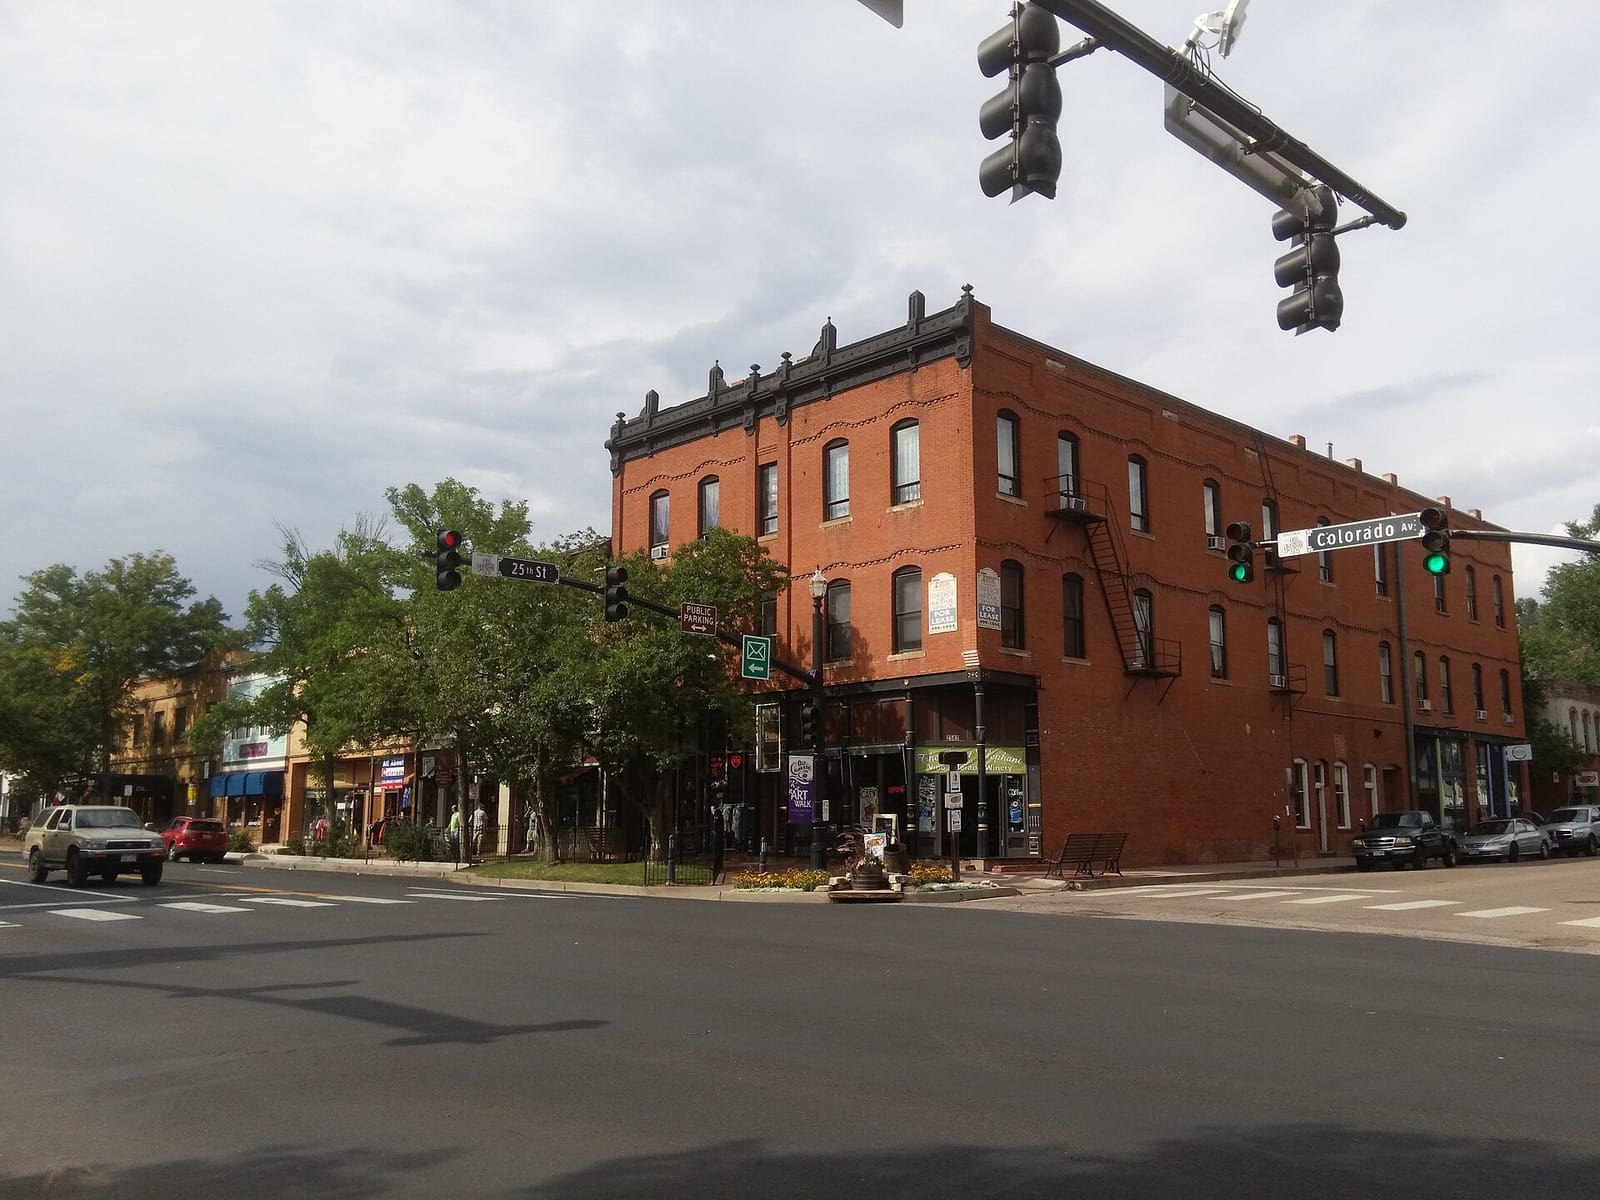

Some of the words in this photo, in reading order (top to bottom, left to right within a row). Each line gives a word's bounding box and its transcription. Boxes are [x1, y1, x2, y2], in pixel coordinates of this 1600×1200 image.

[1317, 523, 1394, 547] Colorado
[511, 562, 534, 576] 25th
[535, 566, 546, 578] St
[686, 605, 711, 616] PUBLIC
[934, 609, 951, 618] FOR
[982, 605, 996, 613] FOR
[683, 613, 714, 625] PARKING
[931, 615, 955, 625] LEASE
[979, 611, 999, 621] LEASE
[791, 788, 809, 800] ART
[794, 799, 812, 808] WALK
